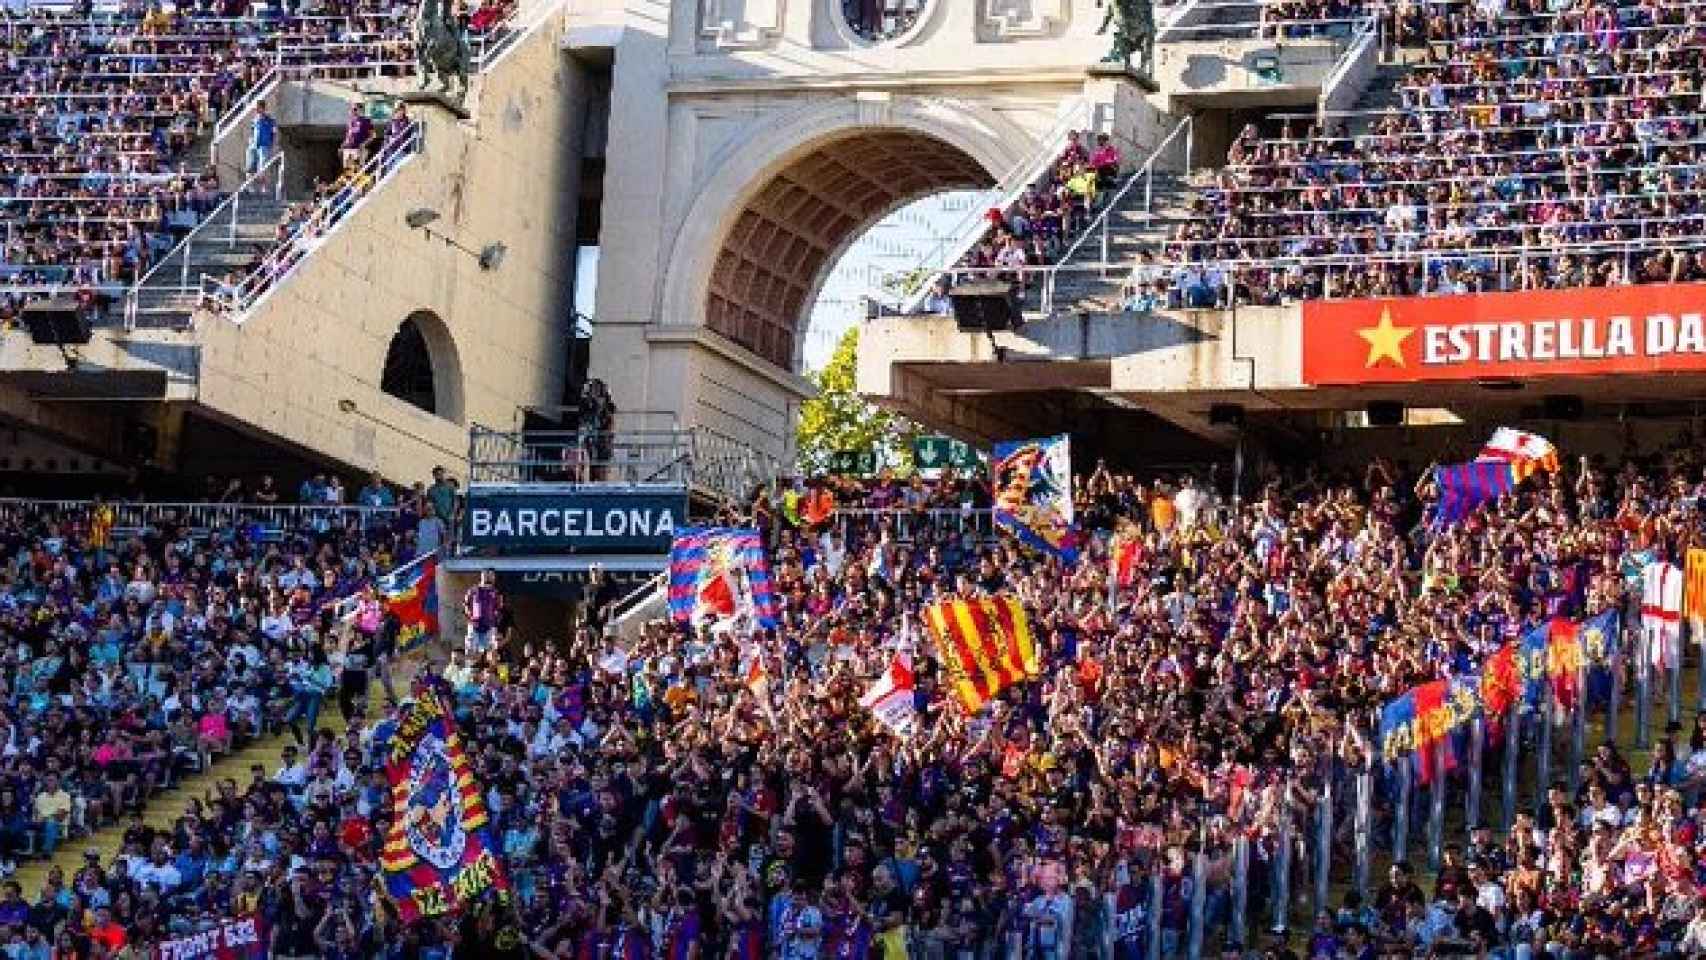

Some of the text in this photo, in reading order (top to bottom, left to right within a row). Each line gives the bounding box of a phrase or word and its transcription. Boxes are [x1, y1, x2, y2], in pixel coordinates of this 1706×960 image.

[1424, 312, 1706, 364] ESTRELLA DA
[471, 508, 674, 537] BARCELONA
